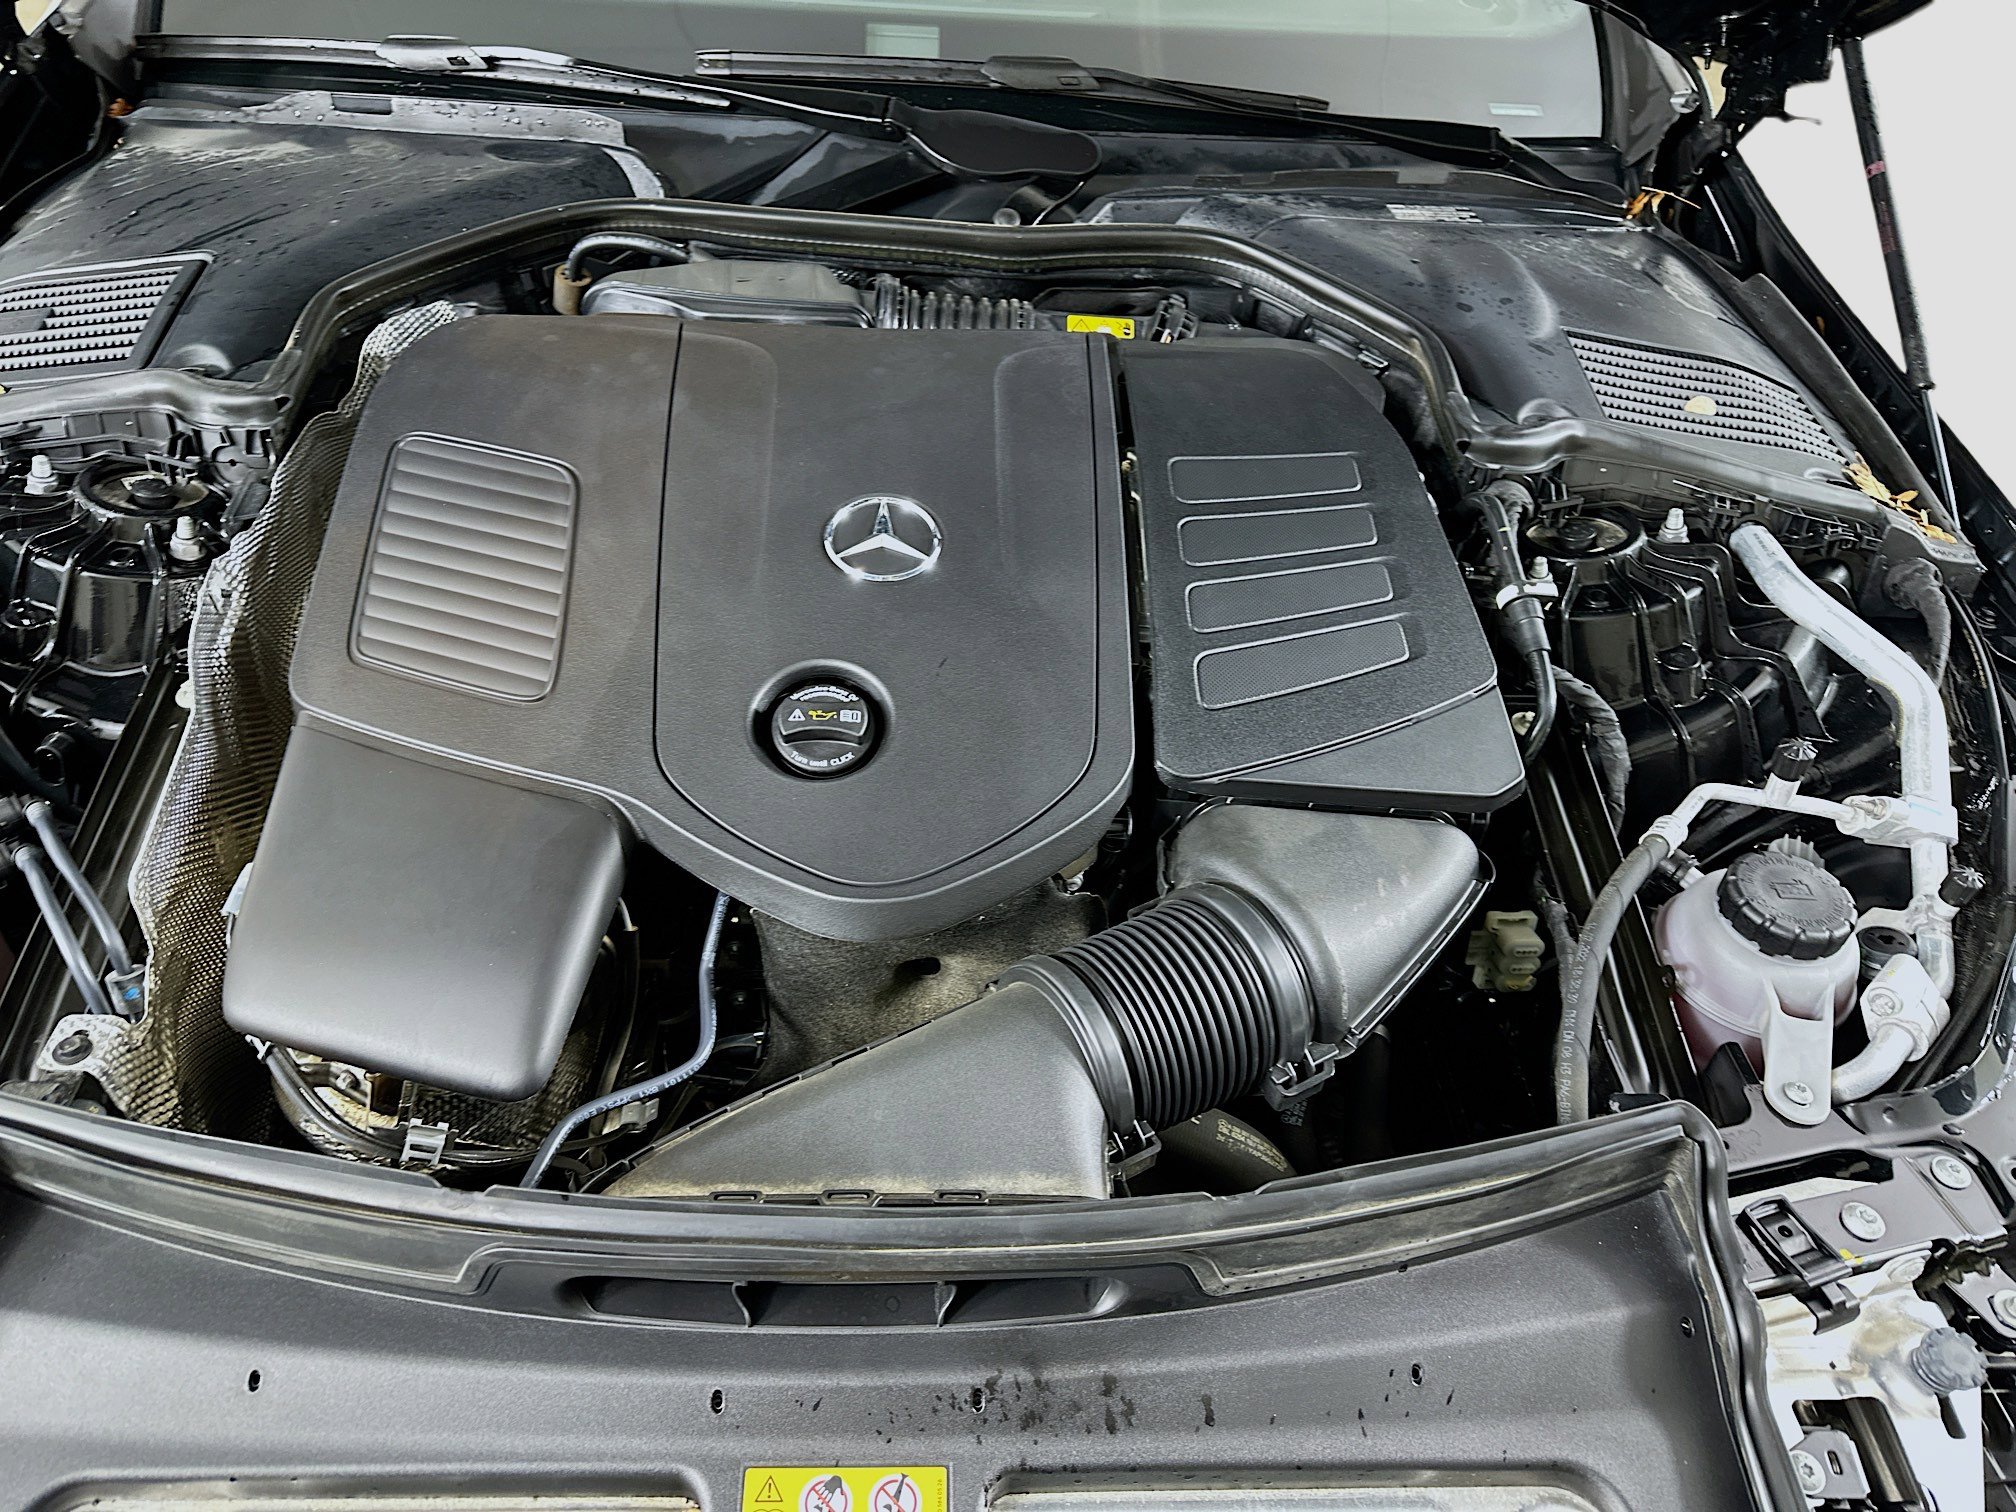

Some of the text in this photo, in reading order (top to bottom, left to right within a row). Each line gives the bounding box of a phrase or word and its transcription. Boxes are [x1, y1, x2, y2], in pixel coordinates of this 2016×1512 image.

[790, 750, 856, 767] Turn until CLICK
